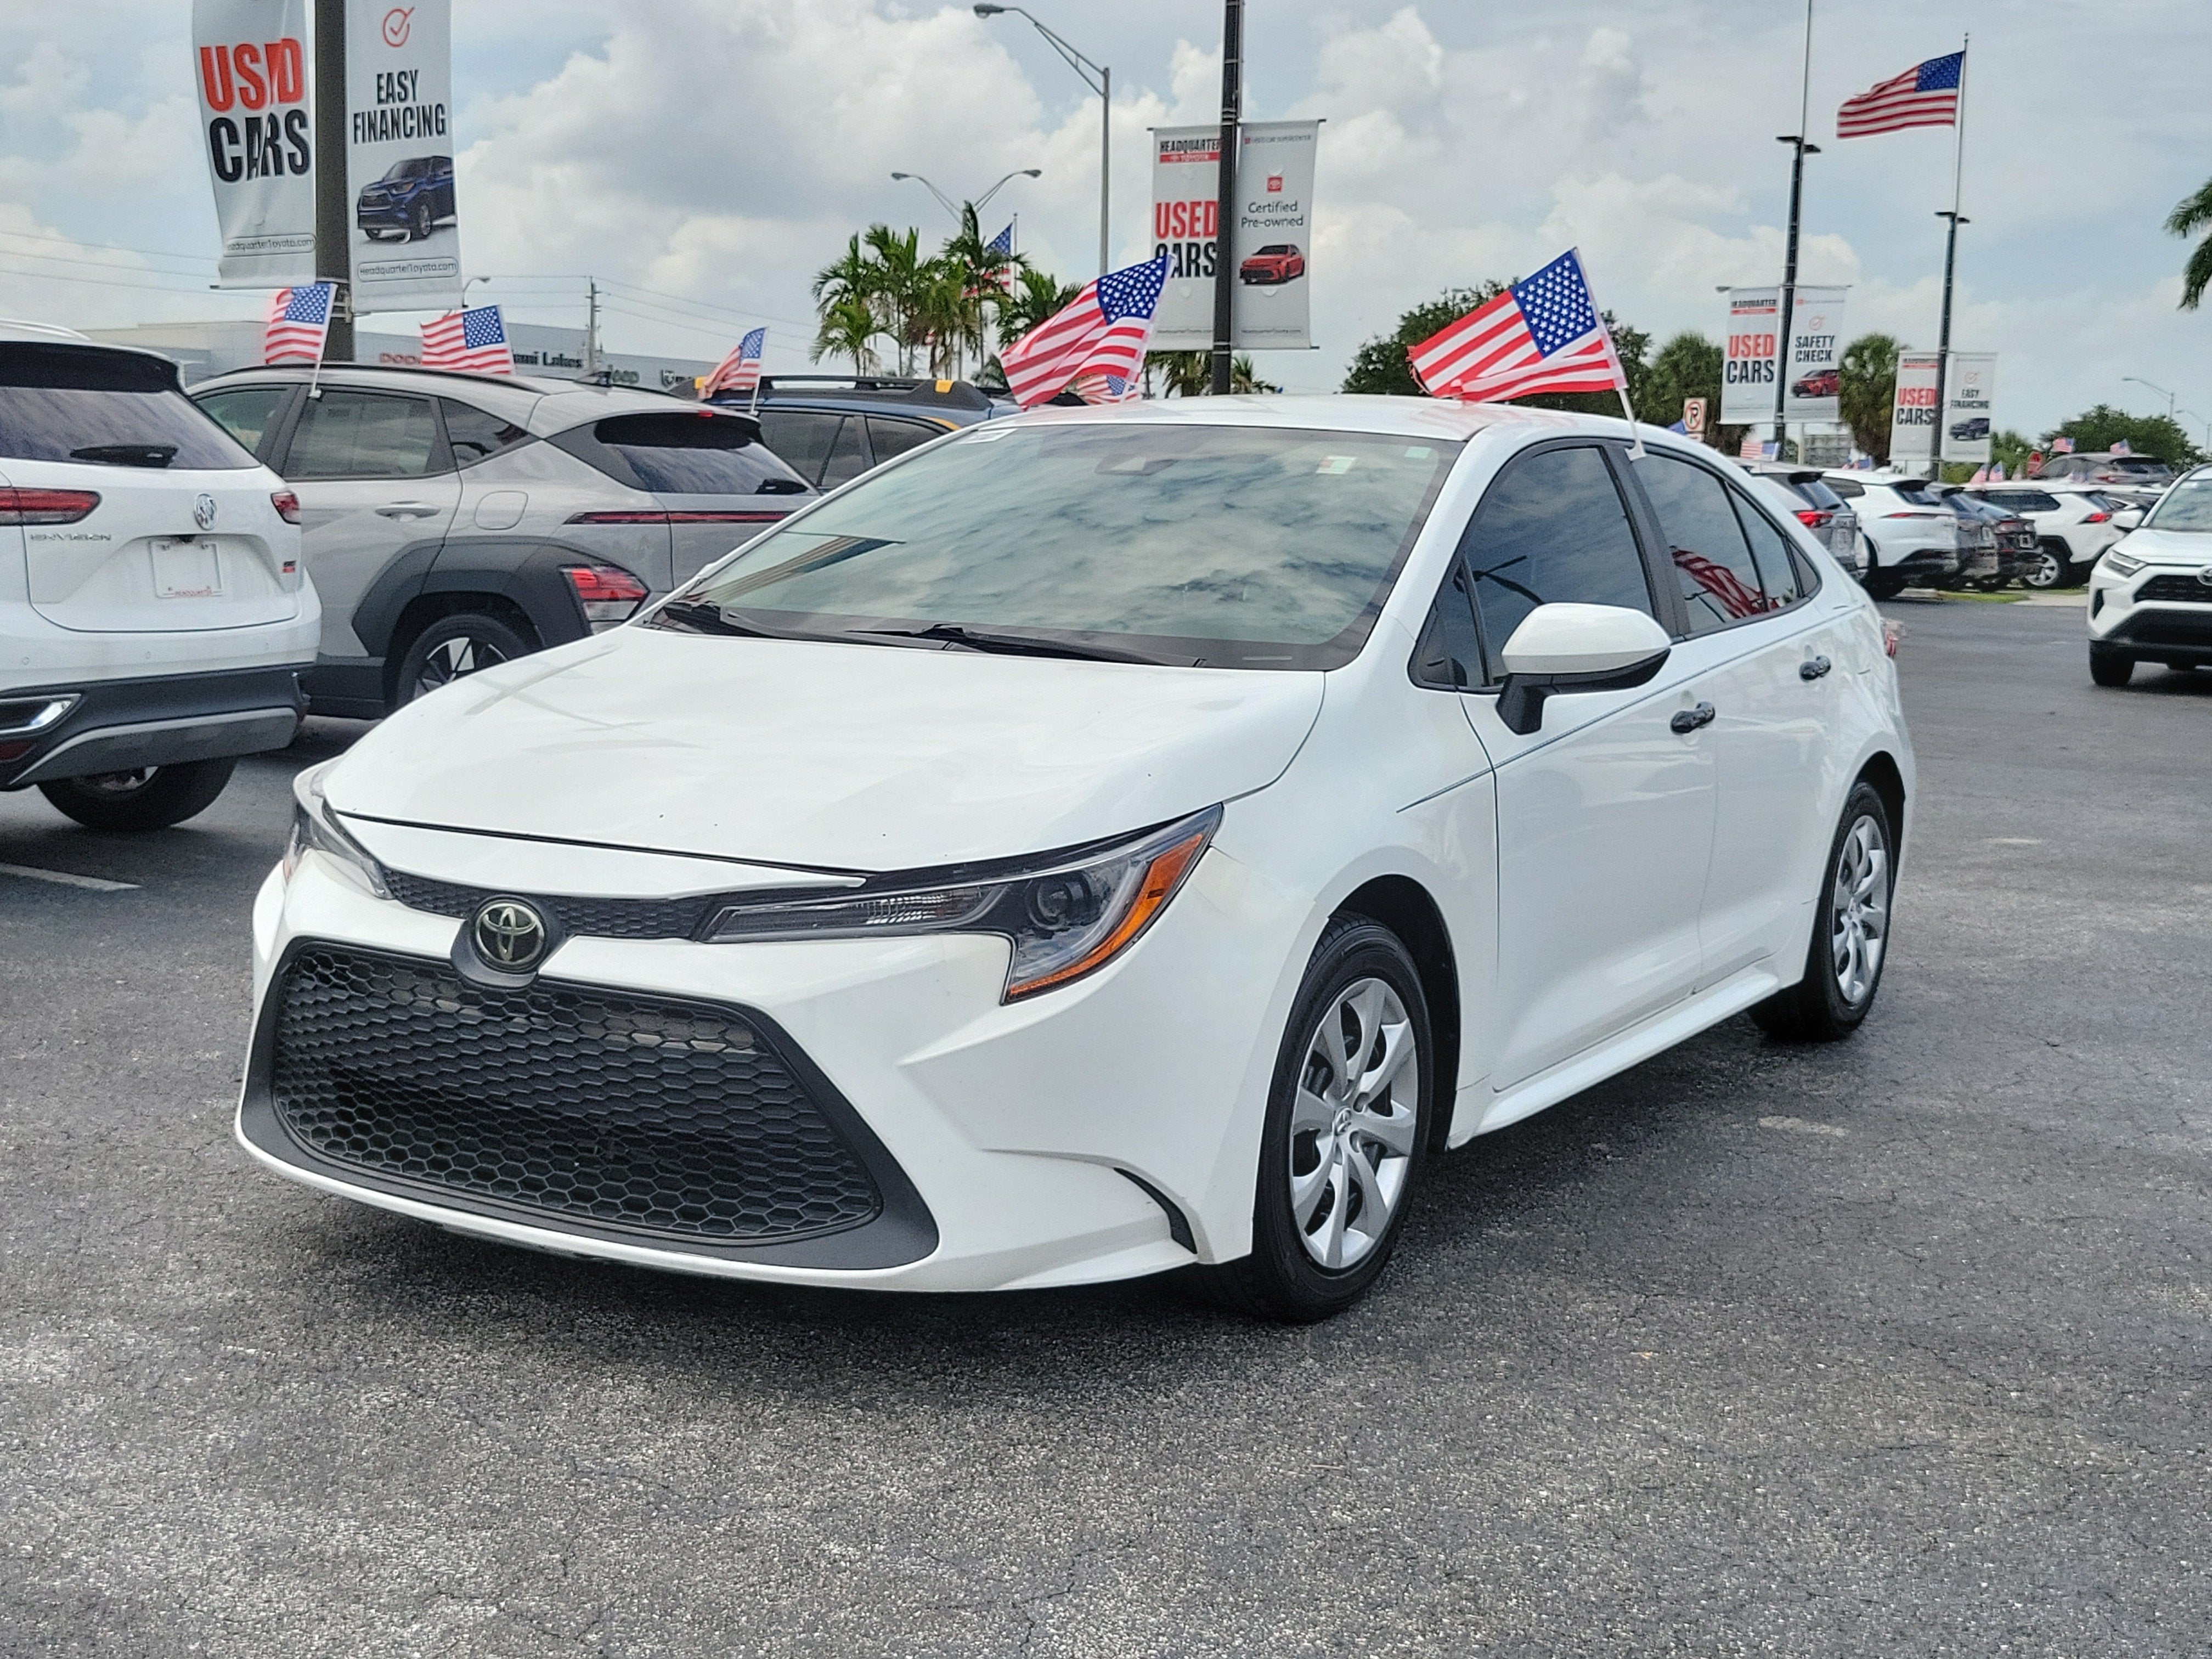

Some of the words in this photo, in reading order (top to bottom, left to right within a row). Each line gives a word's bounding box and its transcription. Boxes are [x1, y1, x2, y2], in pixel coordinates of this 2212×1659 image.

[377, 69, 419, 105] EASY
[353, 103, 447, 144] FINANCING
[1248, 201, 1298, 213] Certified
[1155, 201, 1218, 240] USED
[1241, 215, 1304, 228] Pre-owned
[1729, 334, 1774, 358] USED
[1795, 335, 1835, 348] SAFETY
[1795, 349, 1833, 363] CHECK
[1726, 359, 1775, 384] CARS
[1897, 388, 1937, 406] USED
[1896, 408, 1935, 425] CARS
